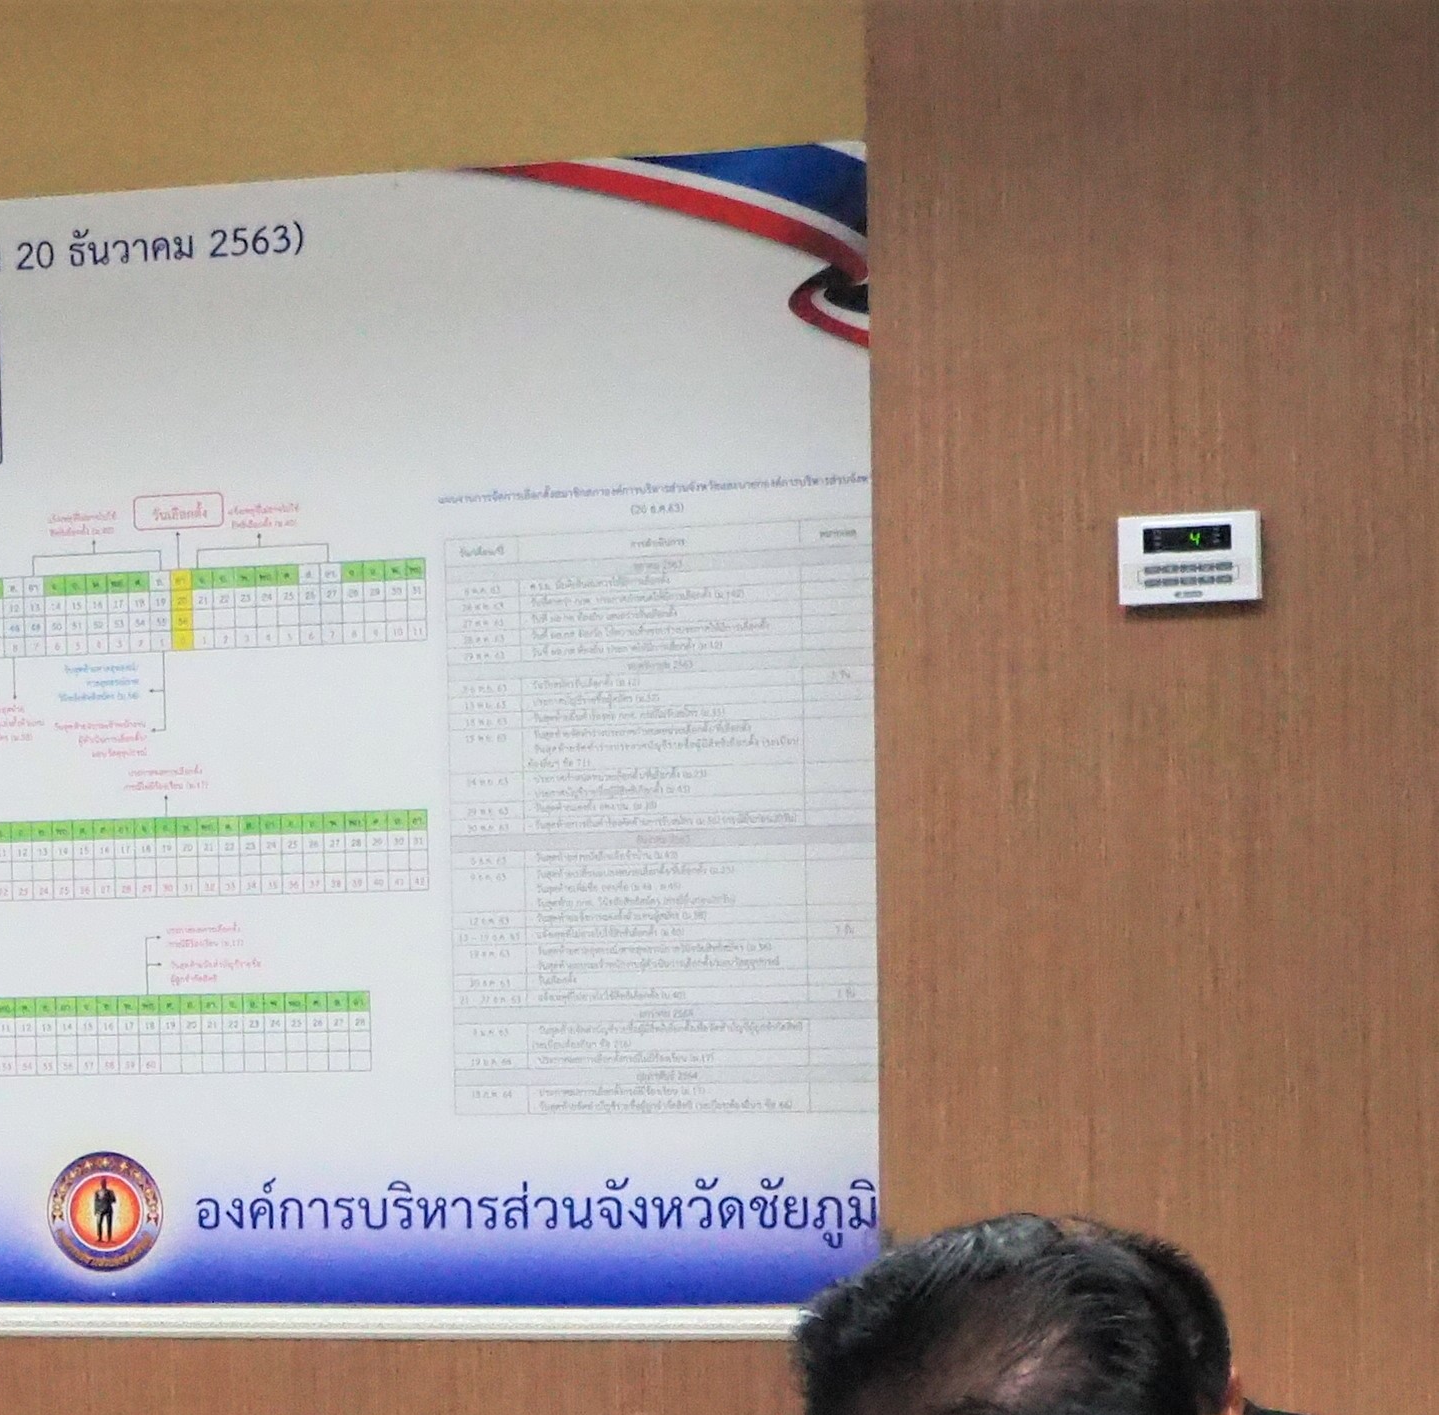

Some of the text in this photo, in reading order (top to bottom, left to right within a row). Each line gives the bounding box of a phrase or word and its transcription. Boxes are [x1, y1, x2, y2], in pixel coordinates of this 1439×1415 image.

[17, 241, 54, 271] 20
[69, 230, 193, 267] ธันวาคม
[210, 221, 305, 258] 2563)
[1189, 532, 1201, 546] 4
[195, 1176, 878, 1249] องค์การบริหารส่วนจังหวัดชัยภูมิ
